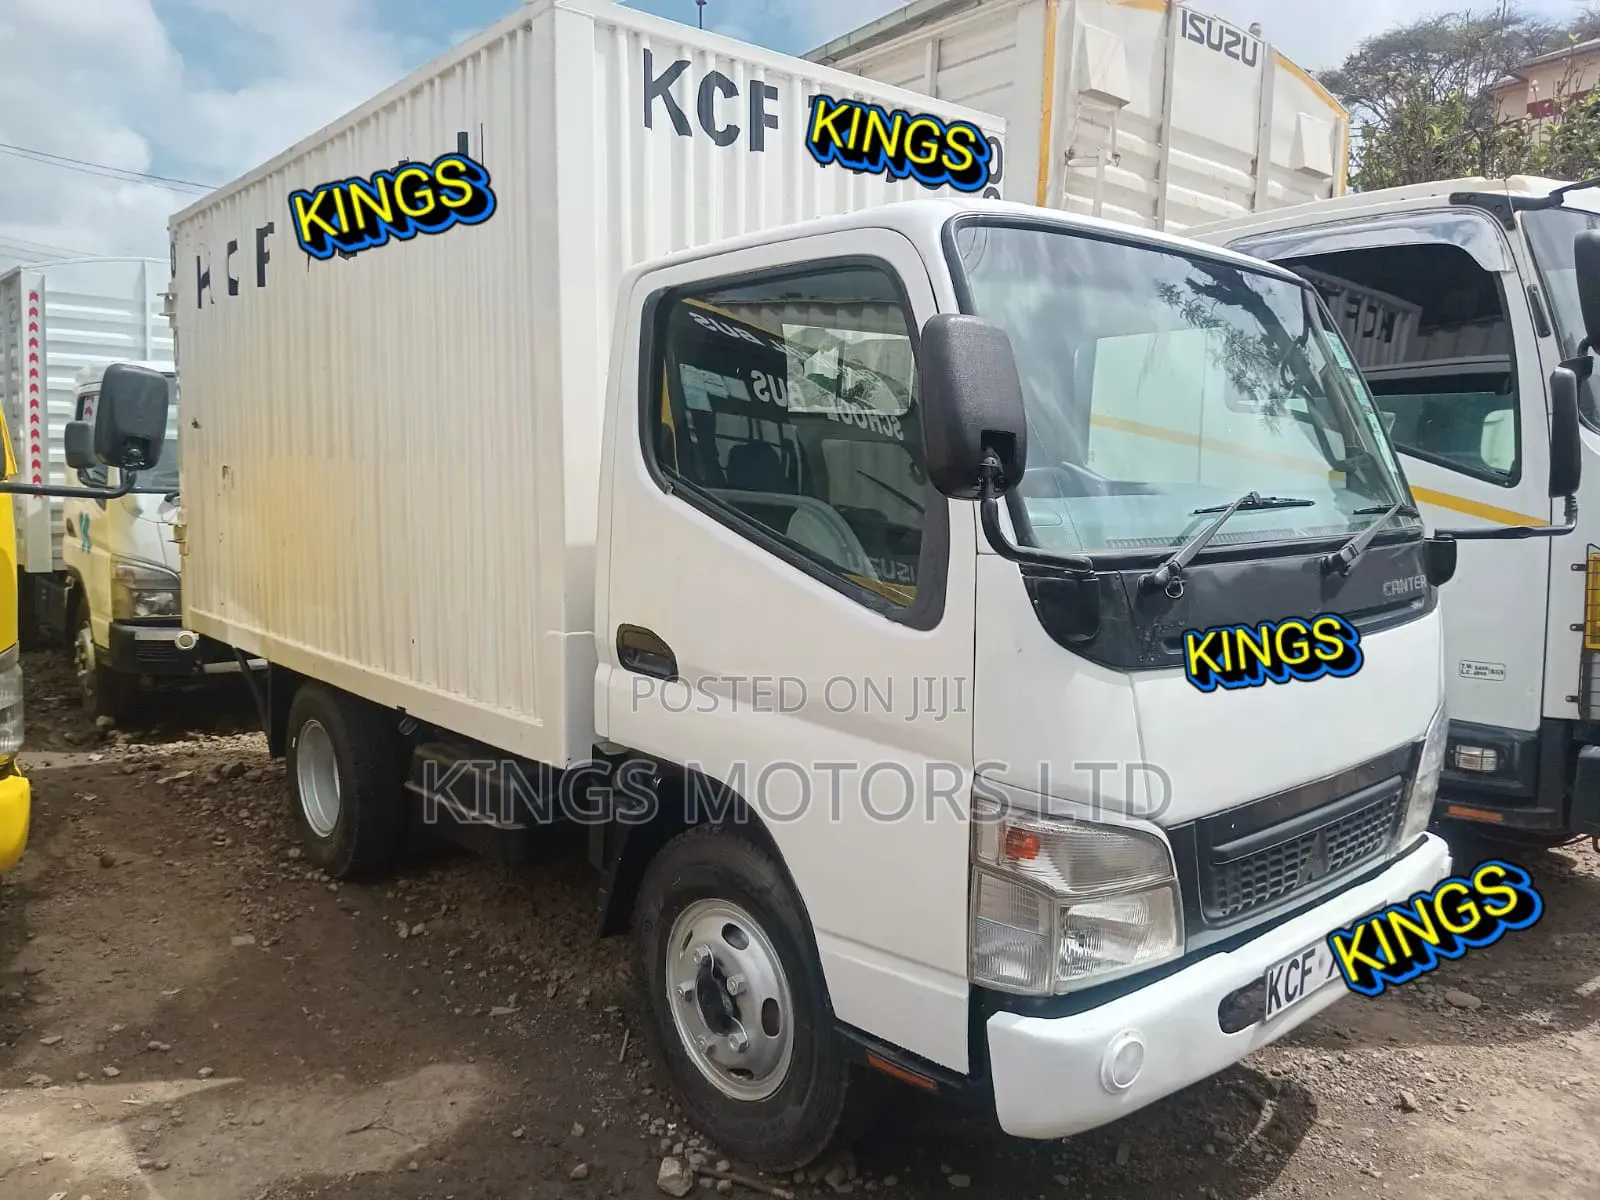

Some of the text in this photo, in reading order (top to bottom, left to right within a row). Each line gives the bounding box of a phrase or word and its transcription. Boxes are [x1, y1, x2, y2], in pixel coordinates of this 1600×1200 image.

[1181, 9, 1258, 68] ISUZU
[643, 47, 779, 152] KCF
[1382, 574, 1428, 597] CANTER
[1266, 948, 1316, 1015] KCF
